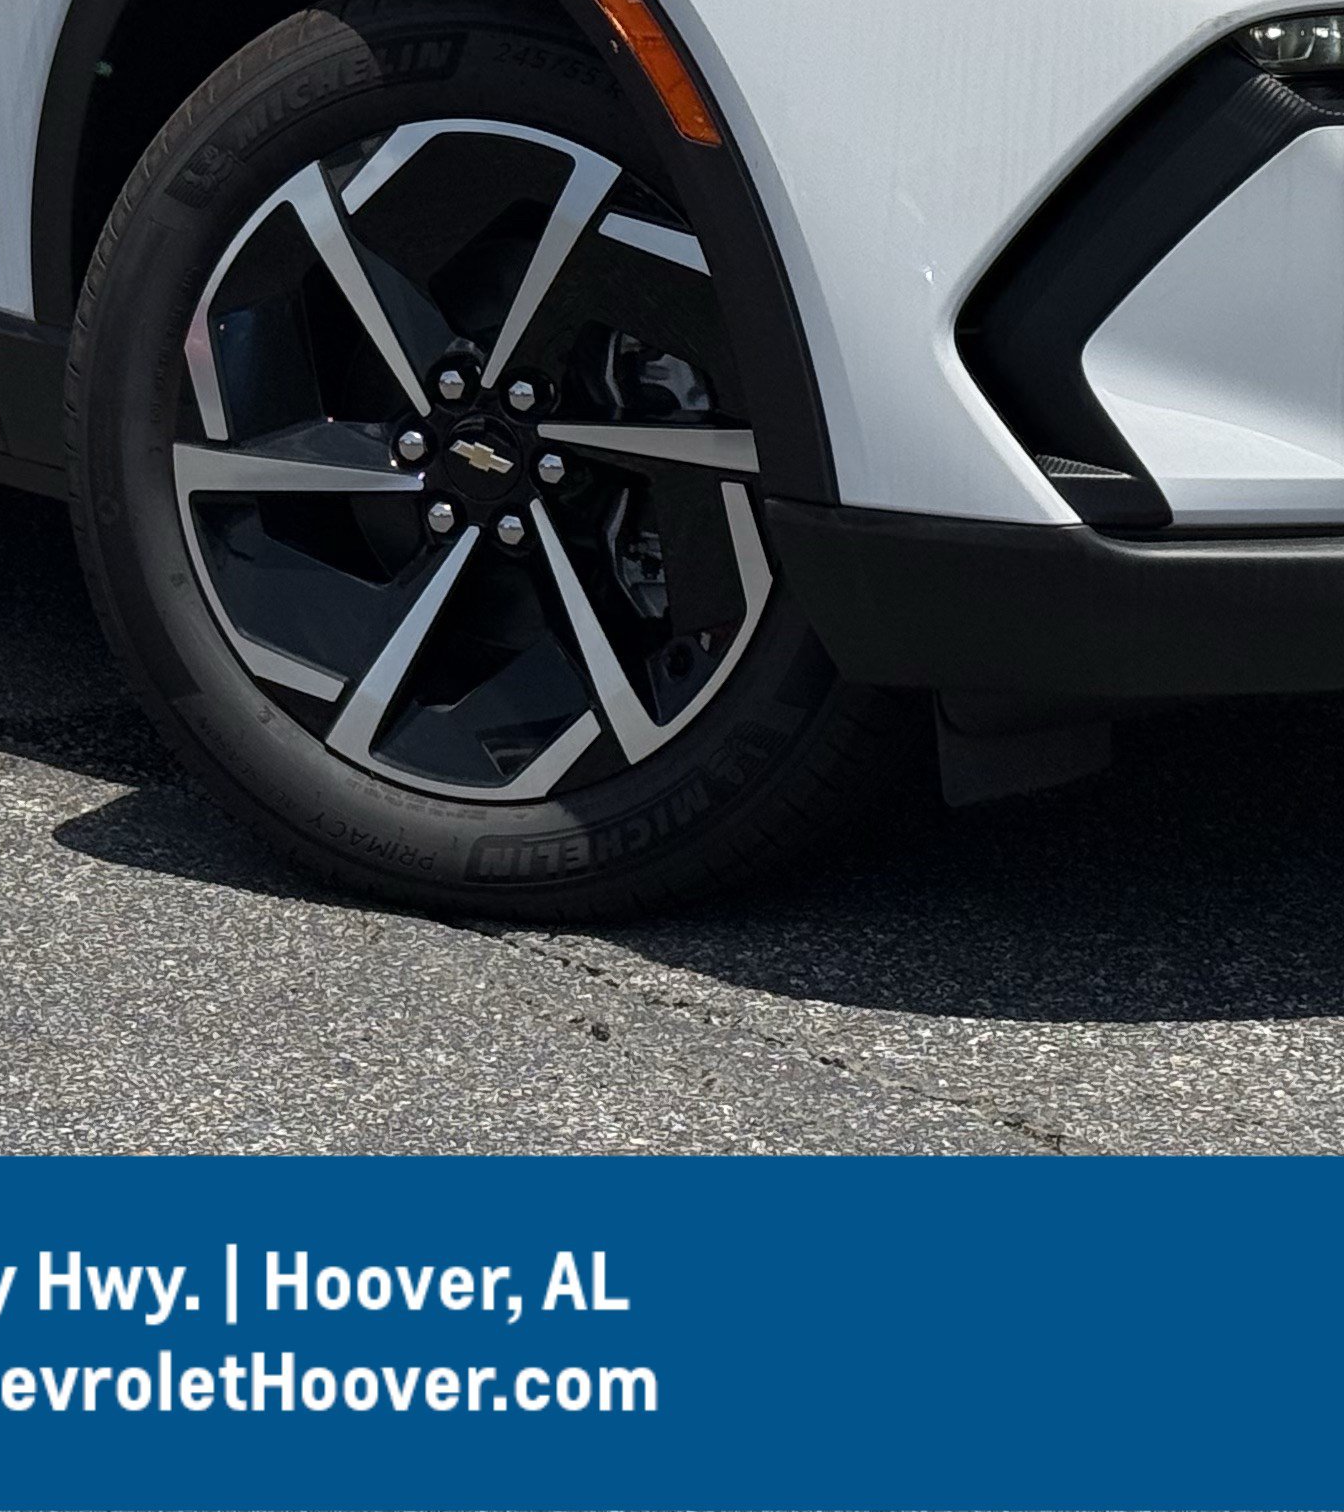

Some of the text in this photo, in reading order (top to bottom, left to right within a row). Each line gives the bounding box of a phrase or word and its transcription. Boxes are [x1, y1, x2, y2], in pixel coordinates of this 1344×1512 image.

[233, 40, 455, 149] MICHELIN
[304, 810, 440, 874] PRIMACY
[476, 779, 712, 879] MICHELIN
